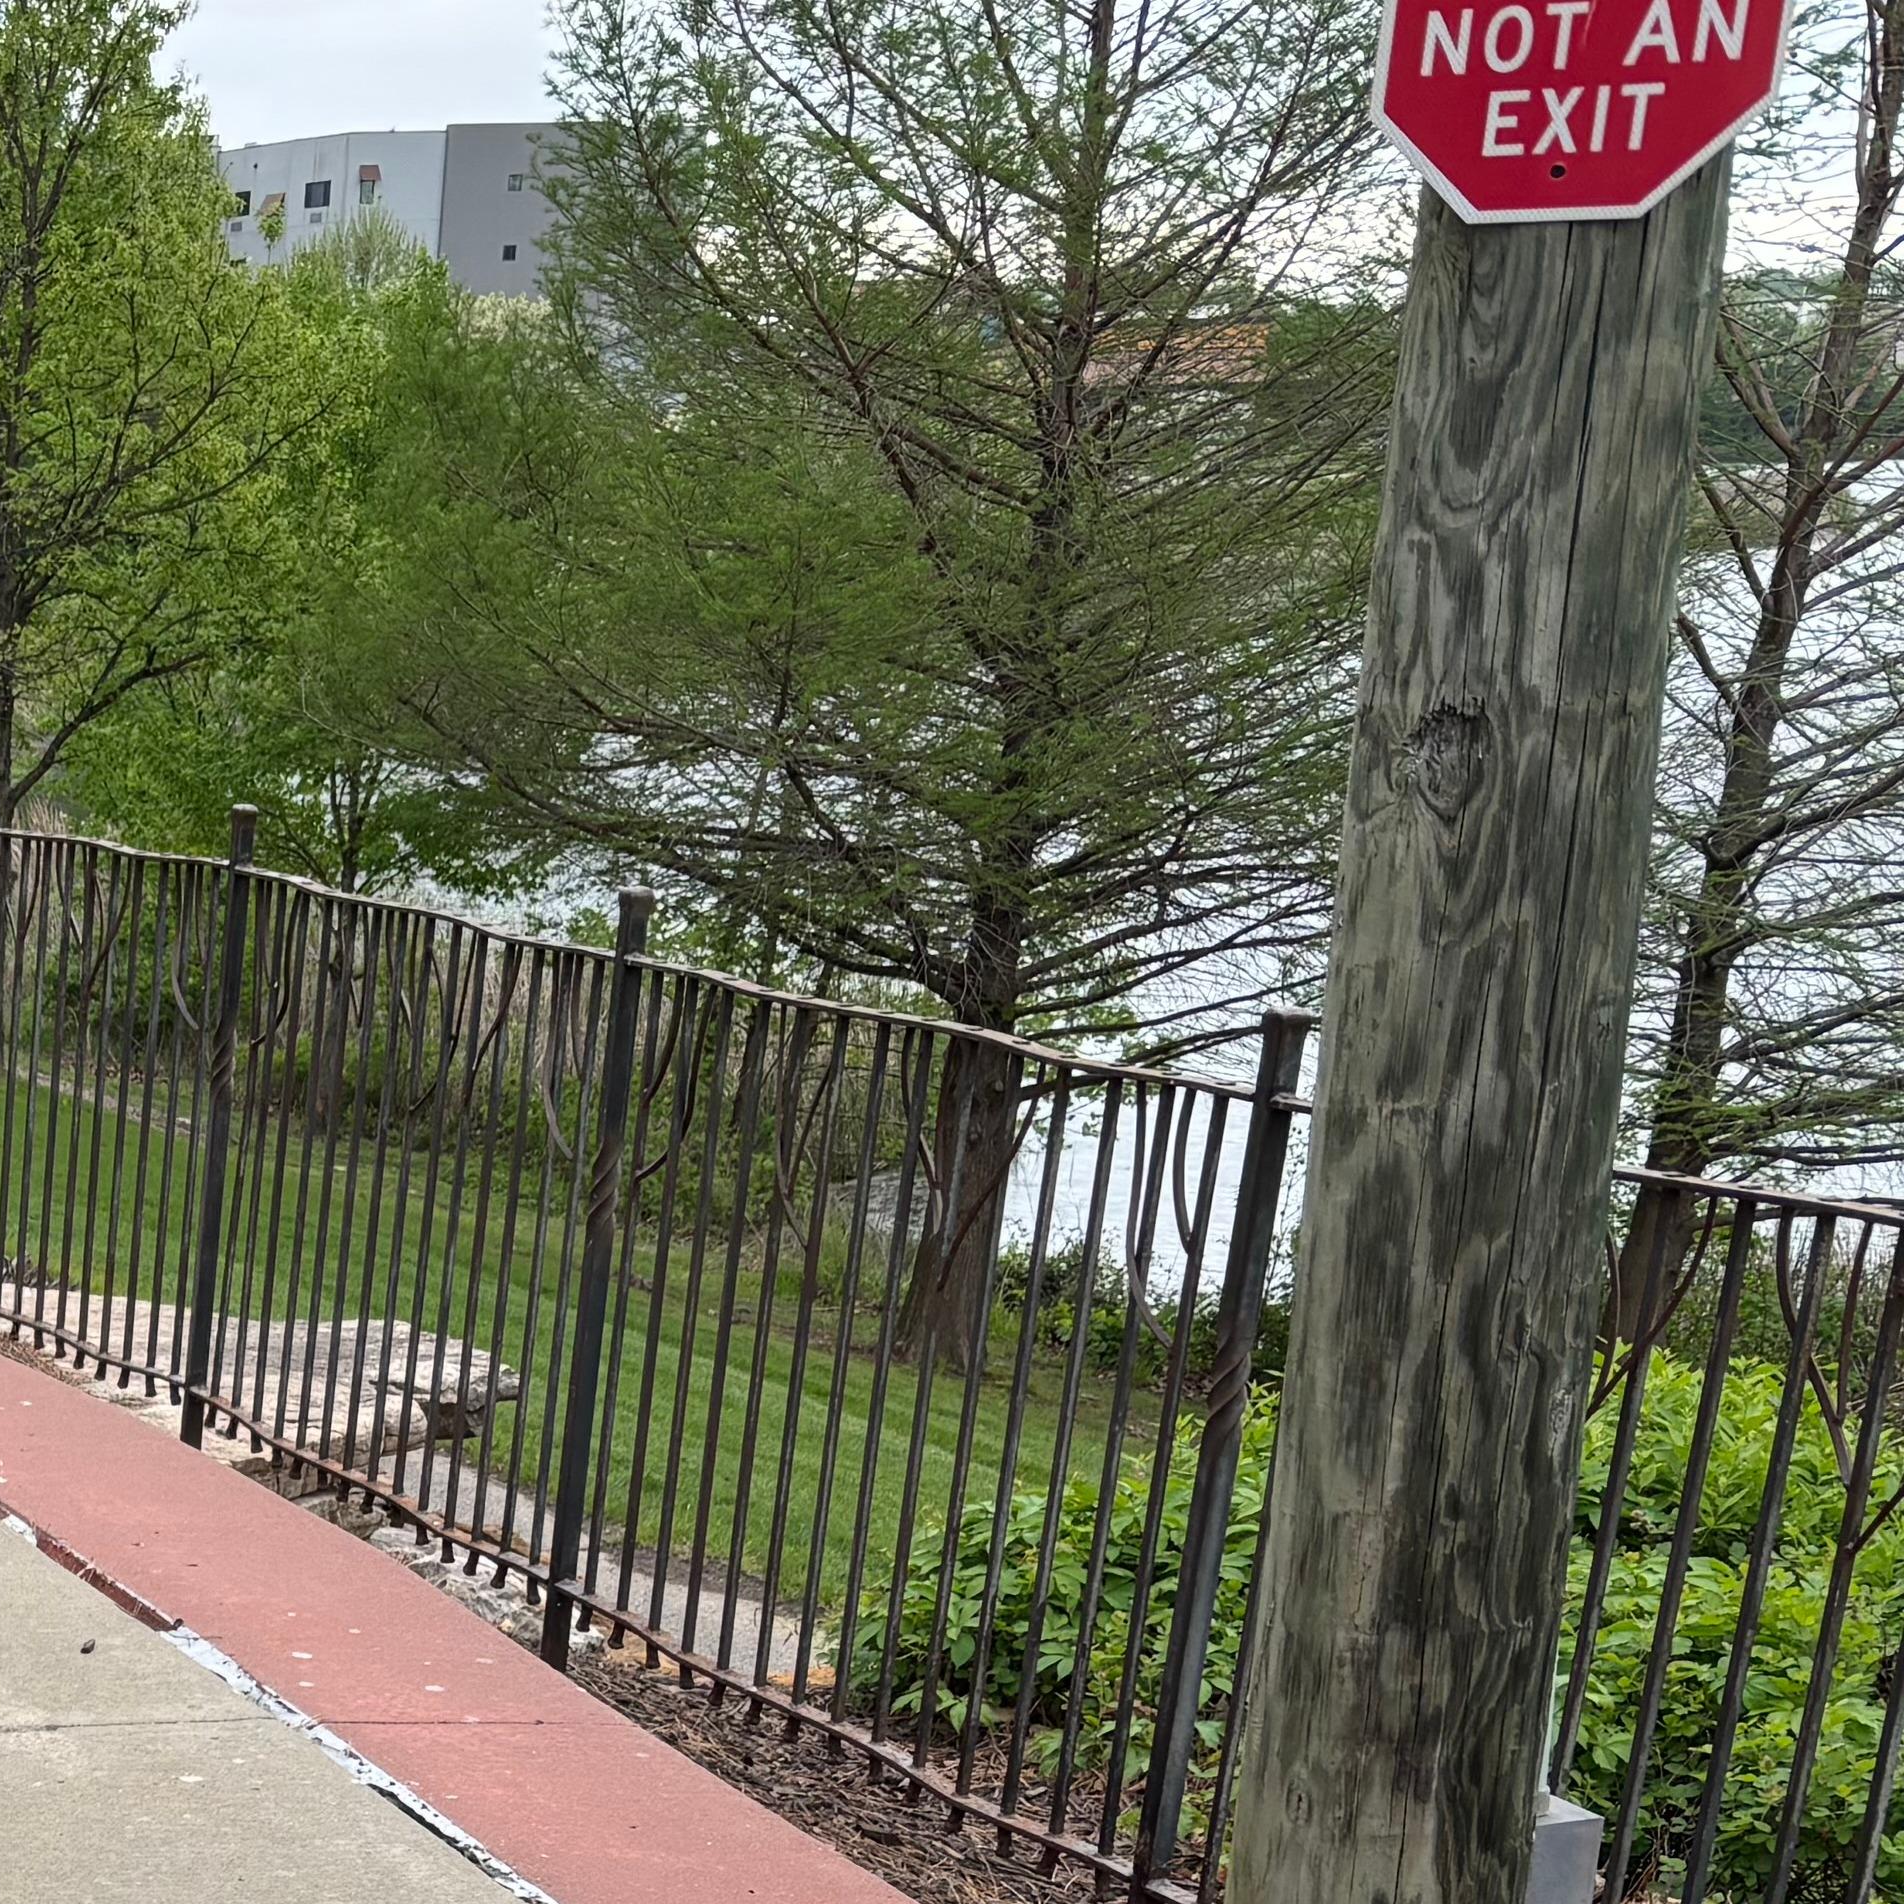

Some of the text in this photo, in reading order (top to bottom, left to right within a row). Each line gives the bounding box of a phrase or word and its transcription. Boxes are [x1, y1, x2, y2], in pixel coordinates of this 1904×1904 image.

[1420, 0, 1749, 77] NOT AN
[1482, 82, 1666, 157] EXIT
